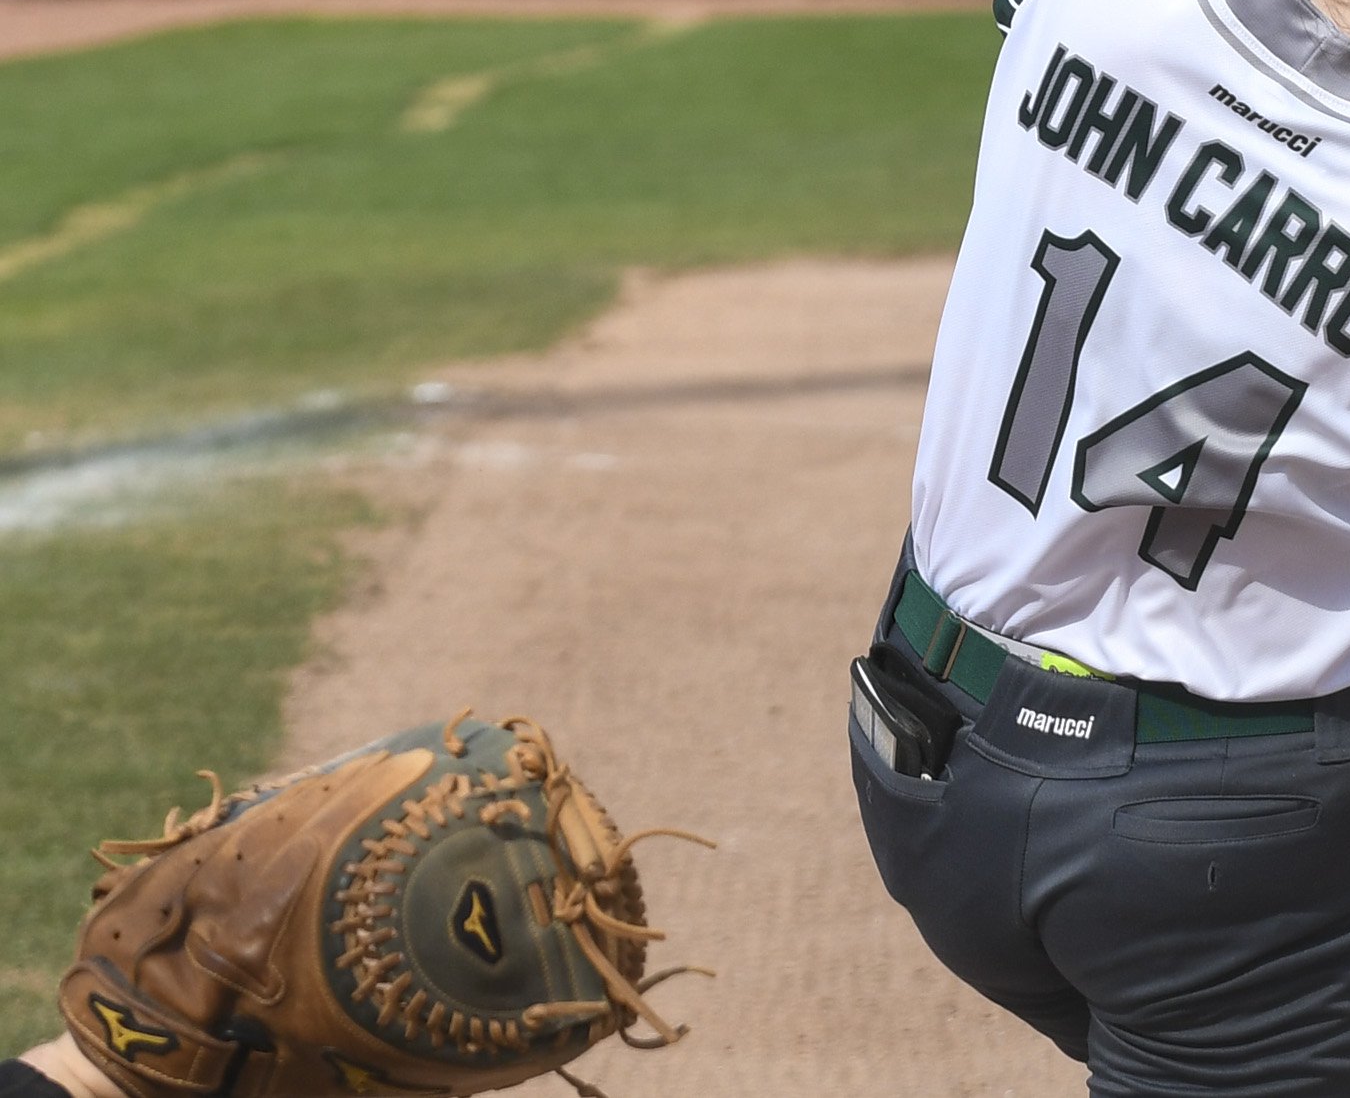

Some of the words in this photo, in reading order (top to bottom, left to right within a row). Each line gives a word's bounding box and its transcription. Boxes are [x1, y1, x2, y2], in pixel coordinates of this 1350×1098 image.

[1017, 42, 1186, 203] JOHN
[1208, 83, 1322, 158] marucci
[987, 228, 1309, 592] 14
[1016, 707, 1095, 739] marucci
